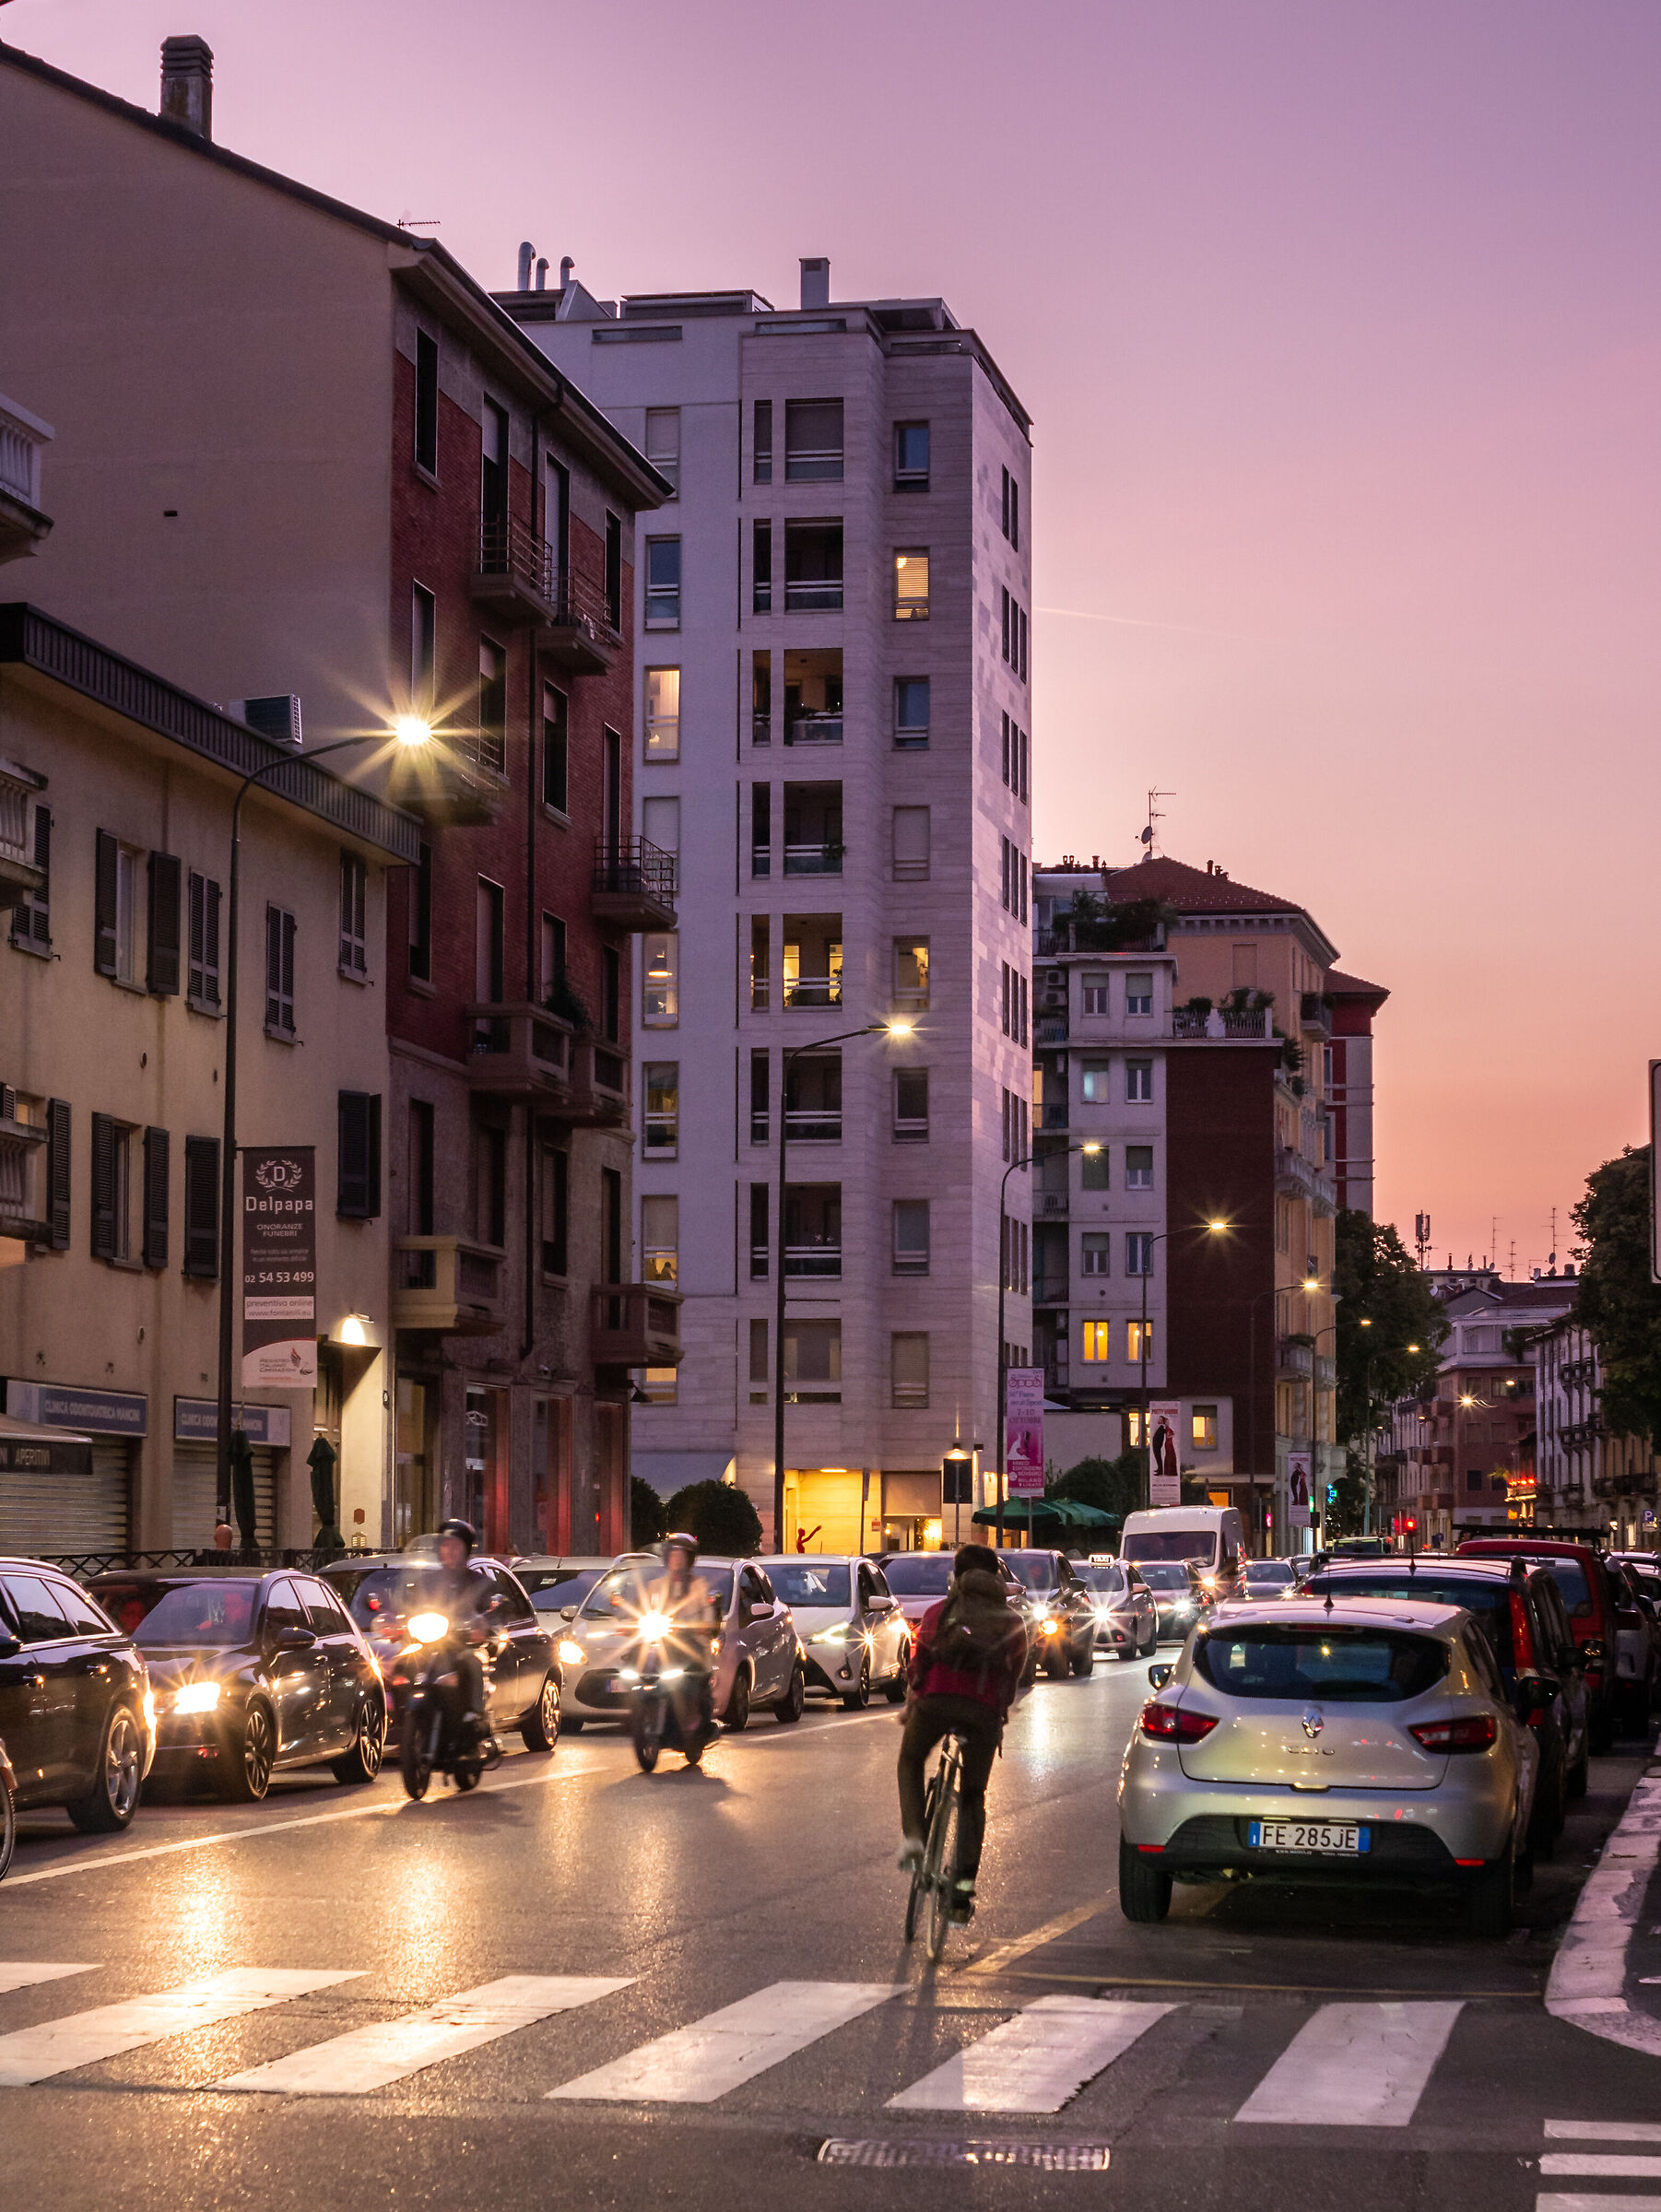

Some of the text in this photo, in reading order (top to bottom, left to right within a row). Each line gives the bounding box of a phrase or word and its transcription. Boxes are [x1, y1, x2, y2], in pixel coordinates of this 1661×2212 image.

[274, 1166, 286, 1182] D
[245, 1196, 313, 1215] Delpapa
[244, 1271, 314, 1283] 02 54 53 499
[246, 1299, 313, 1308] preventivo online
[1644, 1511, 1653, 1521] P
